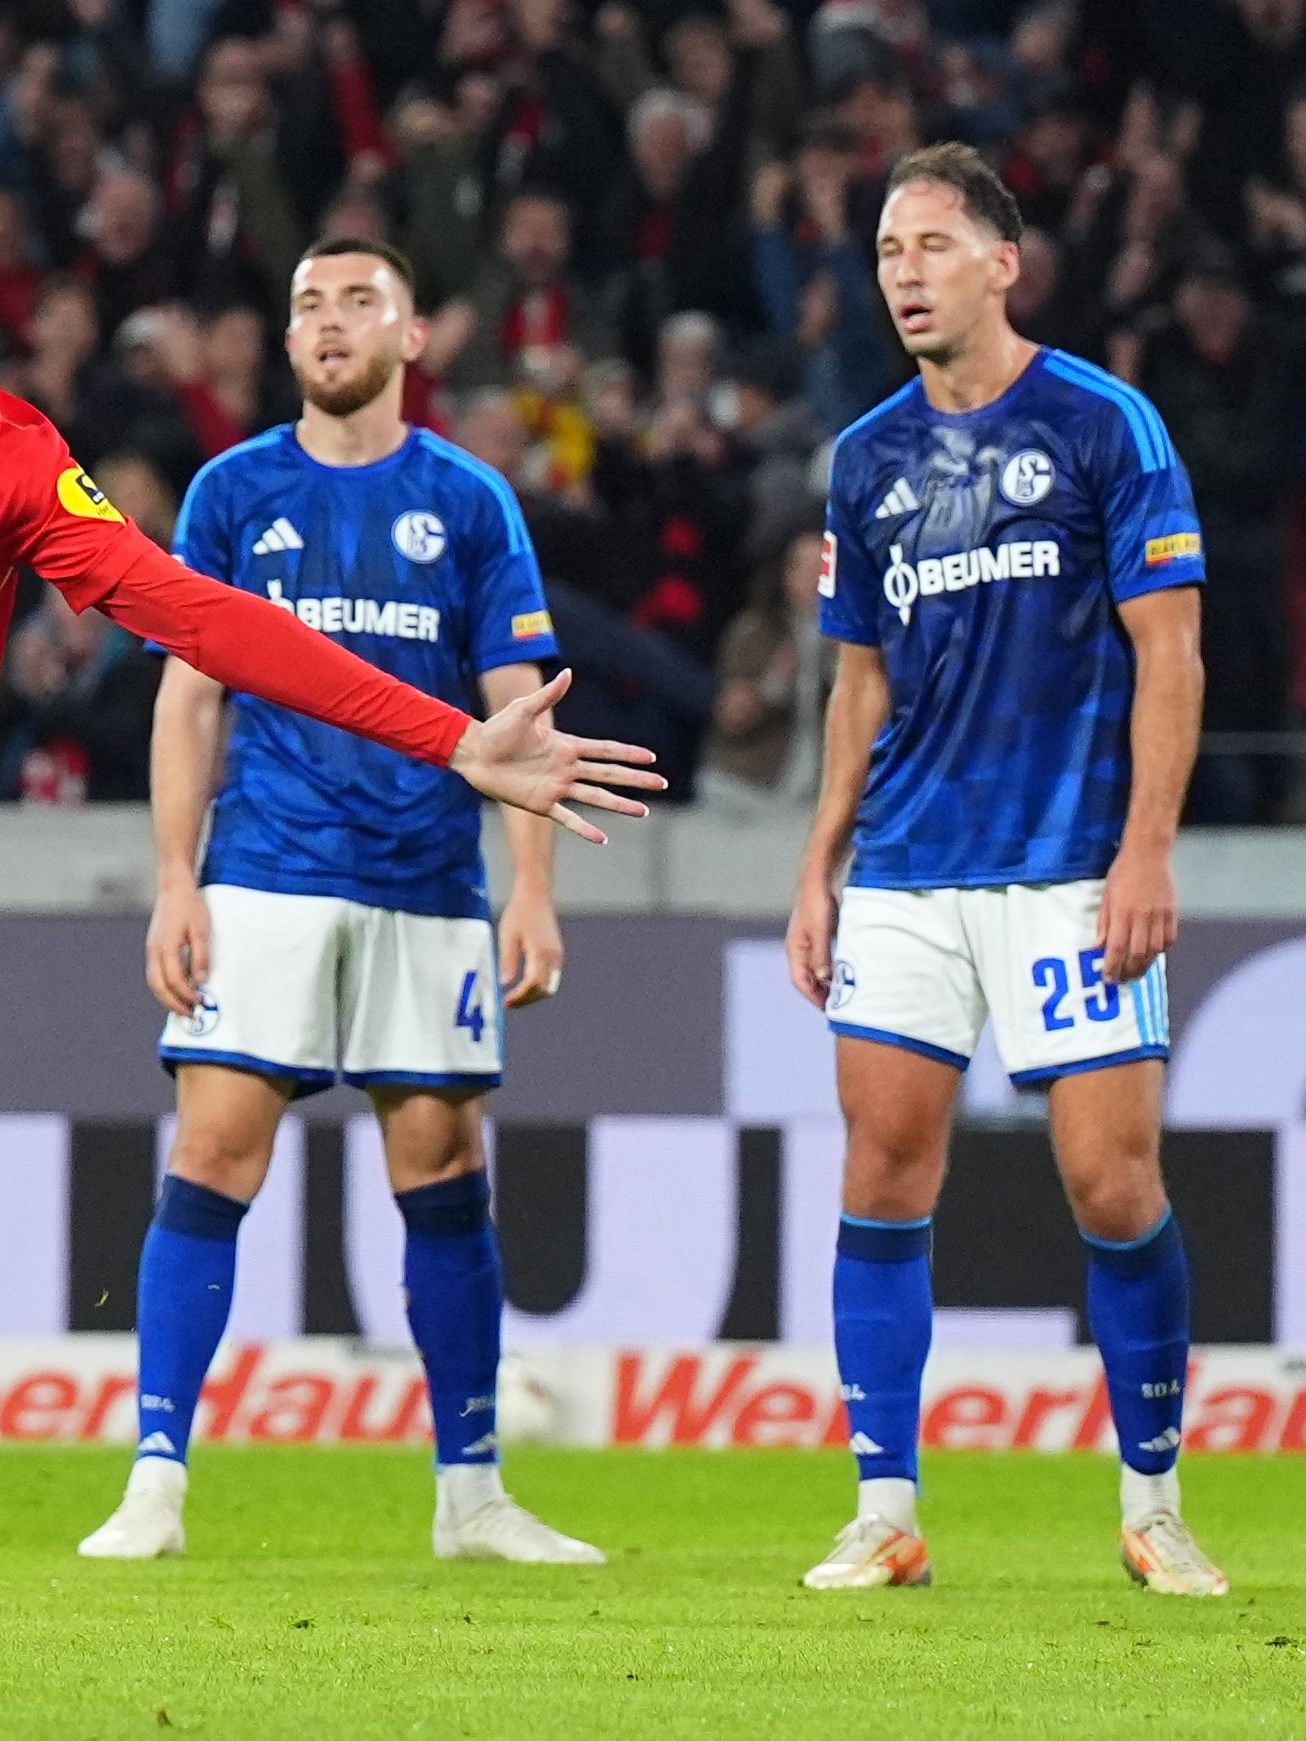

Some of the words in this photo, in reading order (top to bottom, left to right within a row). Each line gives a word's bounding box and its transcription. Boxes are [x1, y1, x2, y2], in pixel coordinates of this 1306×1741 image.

[917, 540, 1061, 597] BEUMER
[296, 596, 440, 643] BEUMER
[455, 970, 486, 1042] 4
[1032, 946, 1121, 1032] 25
[608, 1350, 1306, 1450] Weera
